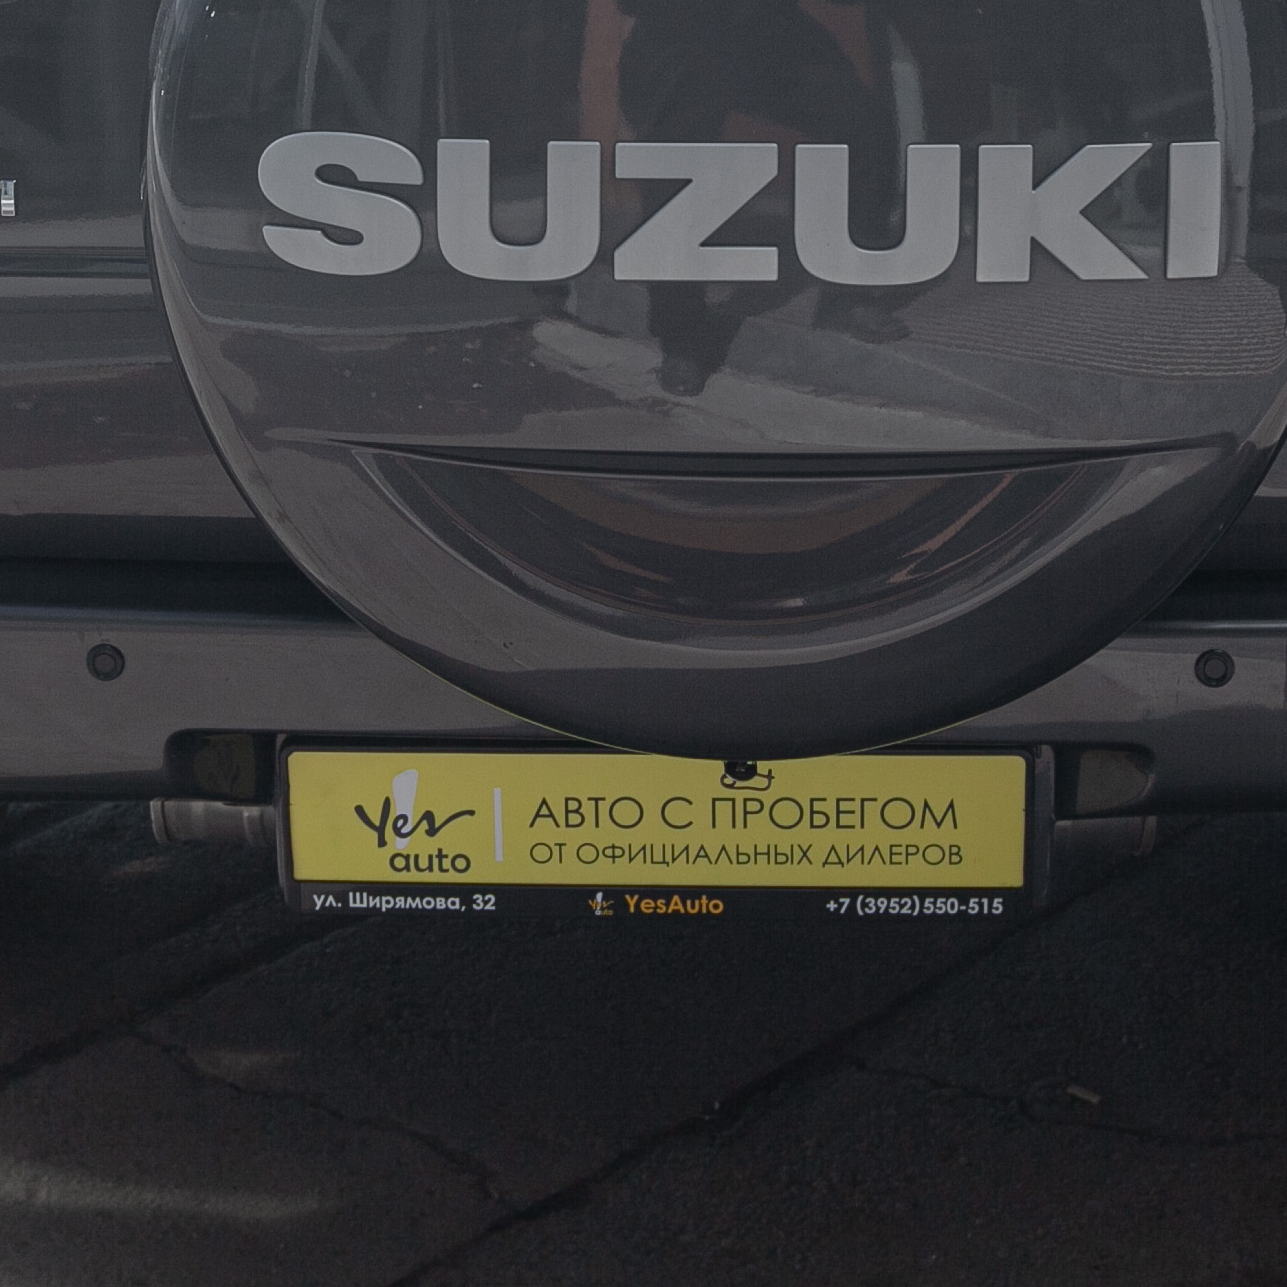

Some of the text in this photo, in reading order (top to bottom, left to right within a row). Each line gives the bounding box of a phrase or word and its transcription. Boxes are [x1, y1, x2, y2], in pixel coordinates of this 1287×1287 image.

[257, 131, 1224, 287] SUZUKI
[354, 792, 476, 849] Yes
[529, 796, 959, 830] АВТО С ПРОБЕГОМ
[388, 848, 472, 874] auto
[528, 842, 963, 868] ОТ ОФИЦИАЛЬНЫХ ДИЛЕРОВ
[313, 891, 496, 912] ул. Ширямова, 32
[624, 894, 724, 914] YesAuto
[826, 898, 850, 914] +7
